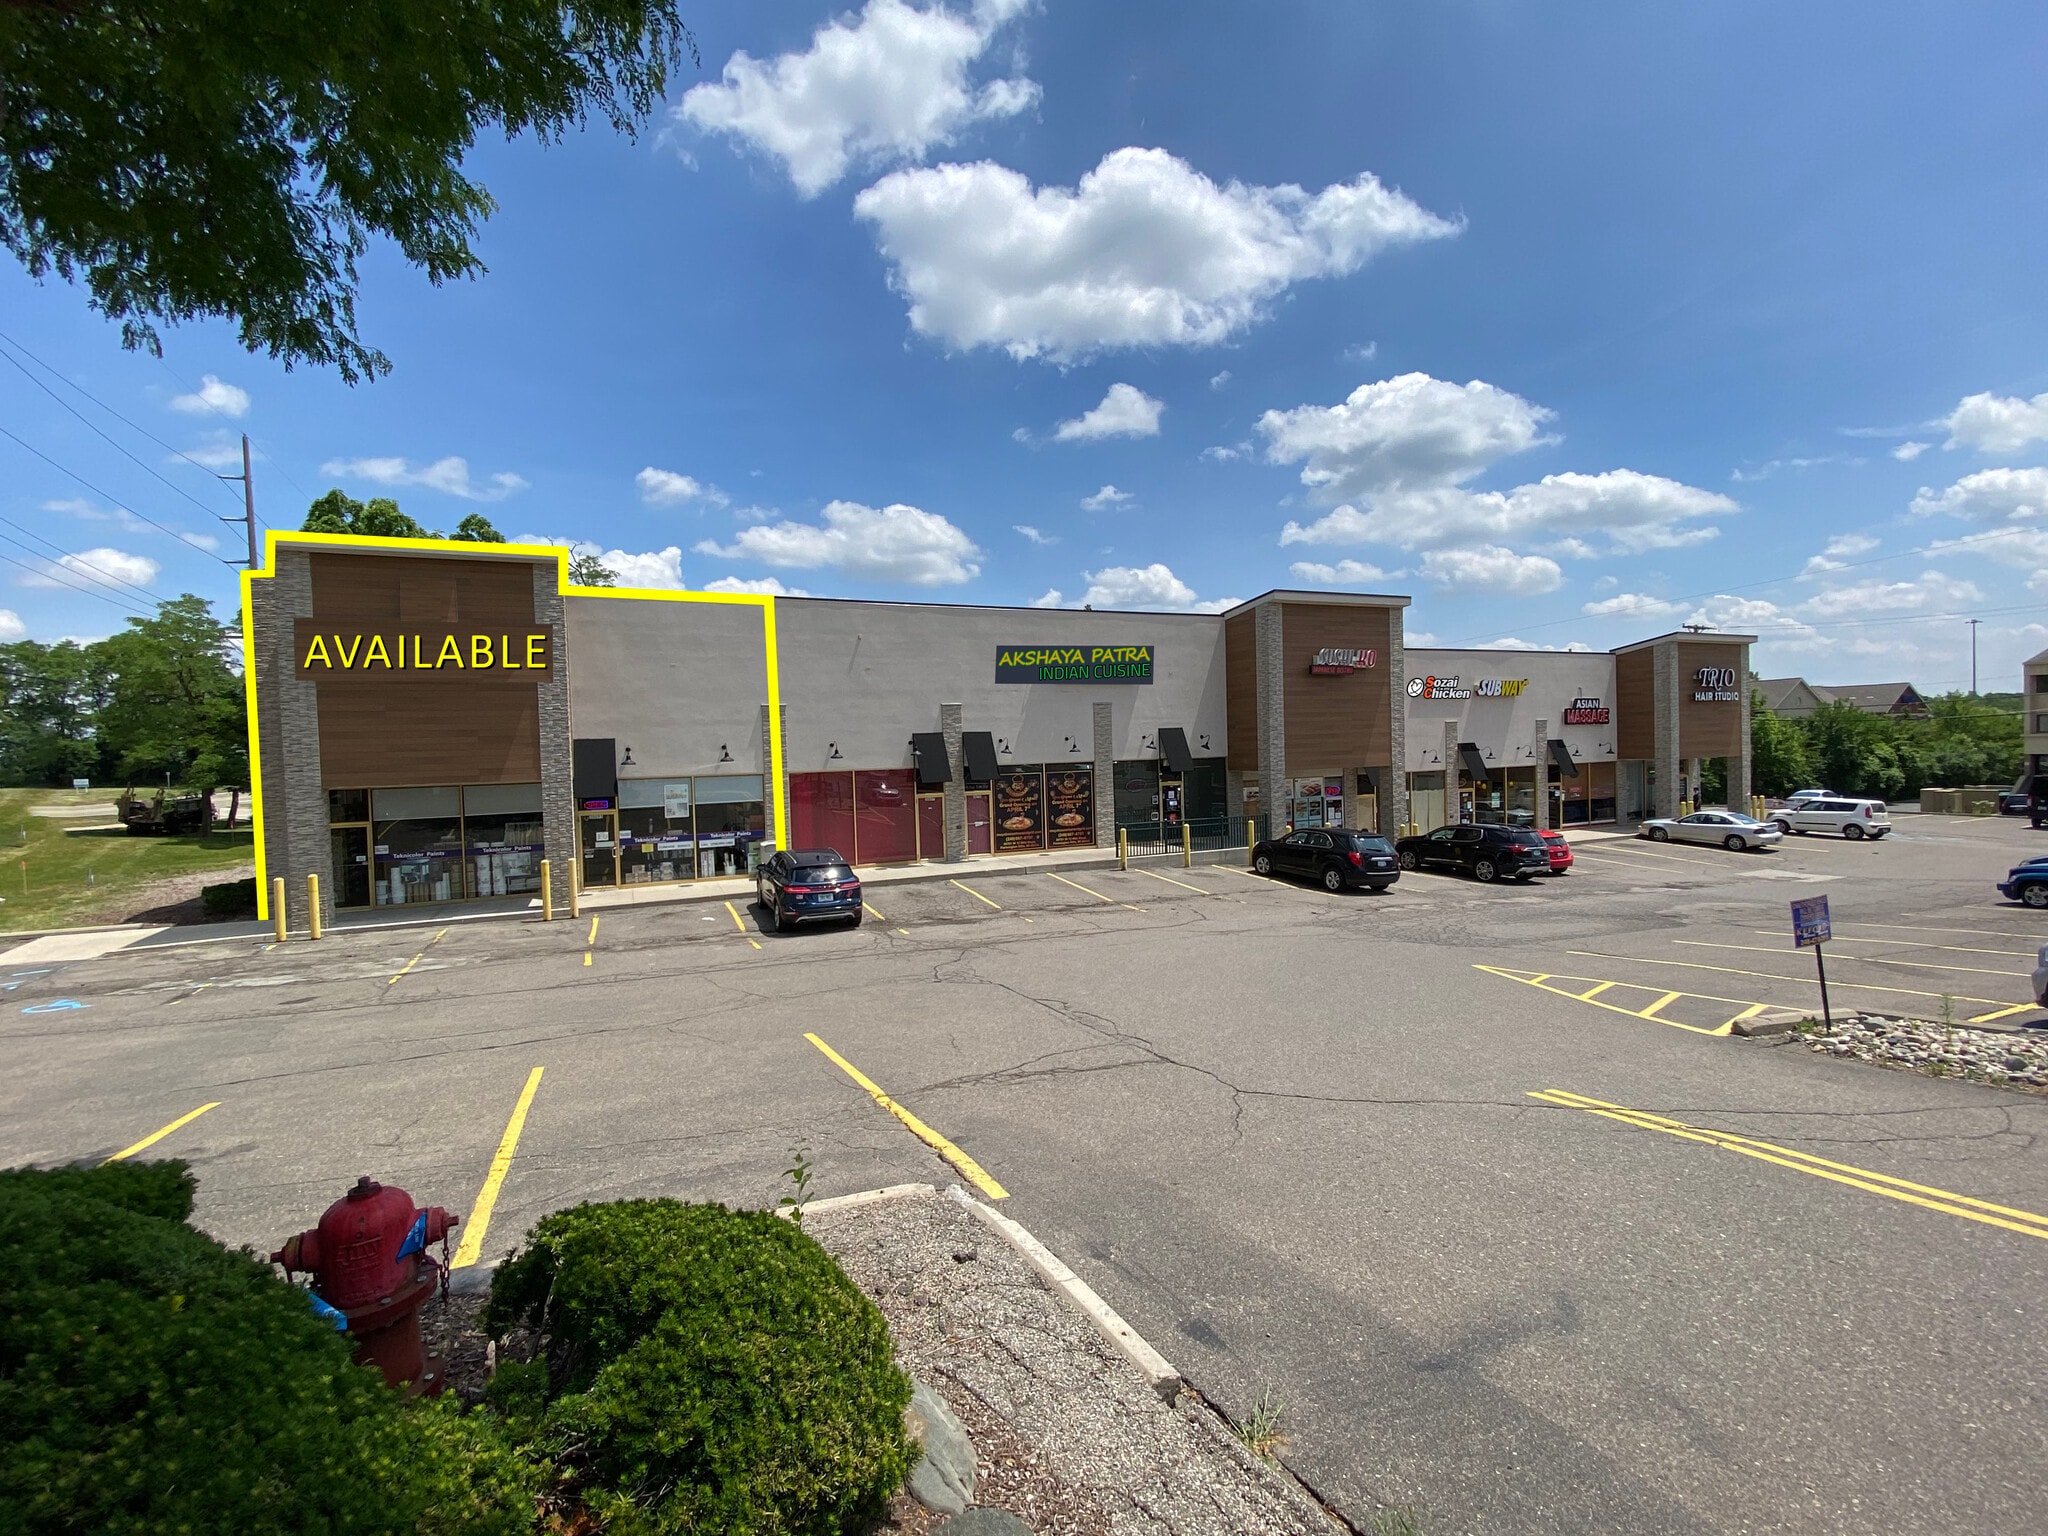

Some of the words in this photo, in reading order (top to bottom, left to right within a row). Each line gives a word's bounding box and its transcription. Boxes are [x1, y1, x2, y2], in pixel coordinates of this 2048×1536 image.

[998, 649, 1085, 667] AKSHAYA
[1091, 647, 1151, 664] PATRA
[1039, 665, 1089, 681] INDIAN
[1093, 663, 1151, 679] CUISINE
[1698, 667, 1735, 691] TRIO
[1425, 676, 1459, 687] Sozai
[1478, 679, 1528, 696] SUBWAY
[1424, 688, 1471, 699] Chicken
[1695, 692, 1713, 701] HAIR
[1715, 692, 1739, 701] STUDIO
[1576, 699, 1599, 708] ASIAN
[1567, 709, 1609, 723] MASSAGE
